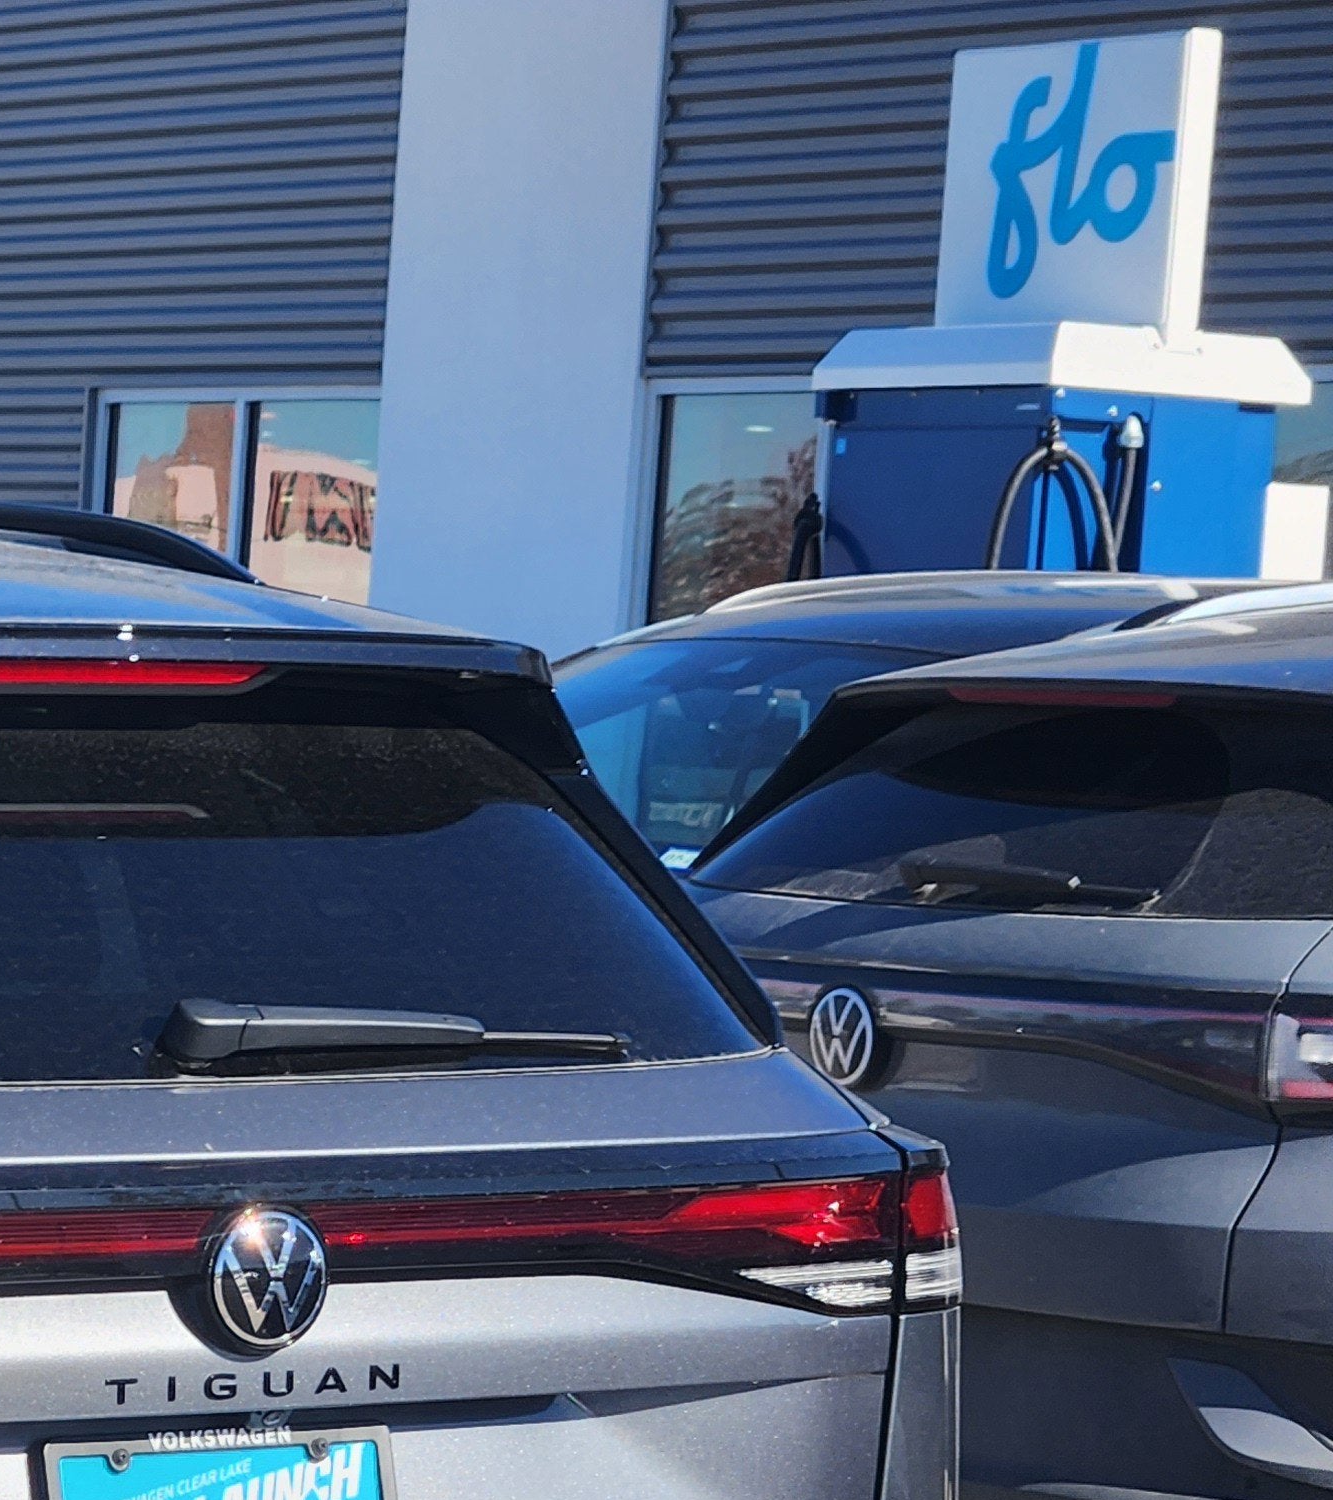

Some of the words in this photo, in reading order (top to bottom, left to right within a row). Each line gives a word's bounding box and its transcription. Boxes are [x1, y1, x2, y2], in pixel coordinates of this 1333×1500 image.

[988, 43, 1175, 298] flo
[104, 1364, 401, 1405] TIGUAN
[148, 1425, 292, 1451] VOLKSWAGEN
[176, 1469, 217, 1496] CLEAR
[219, 1457, 252, 1480] LAKE
